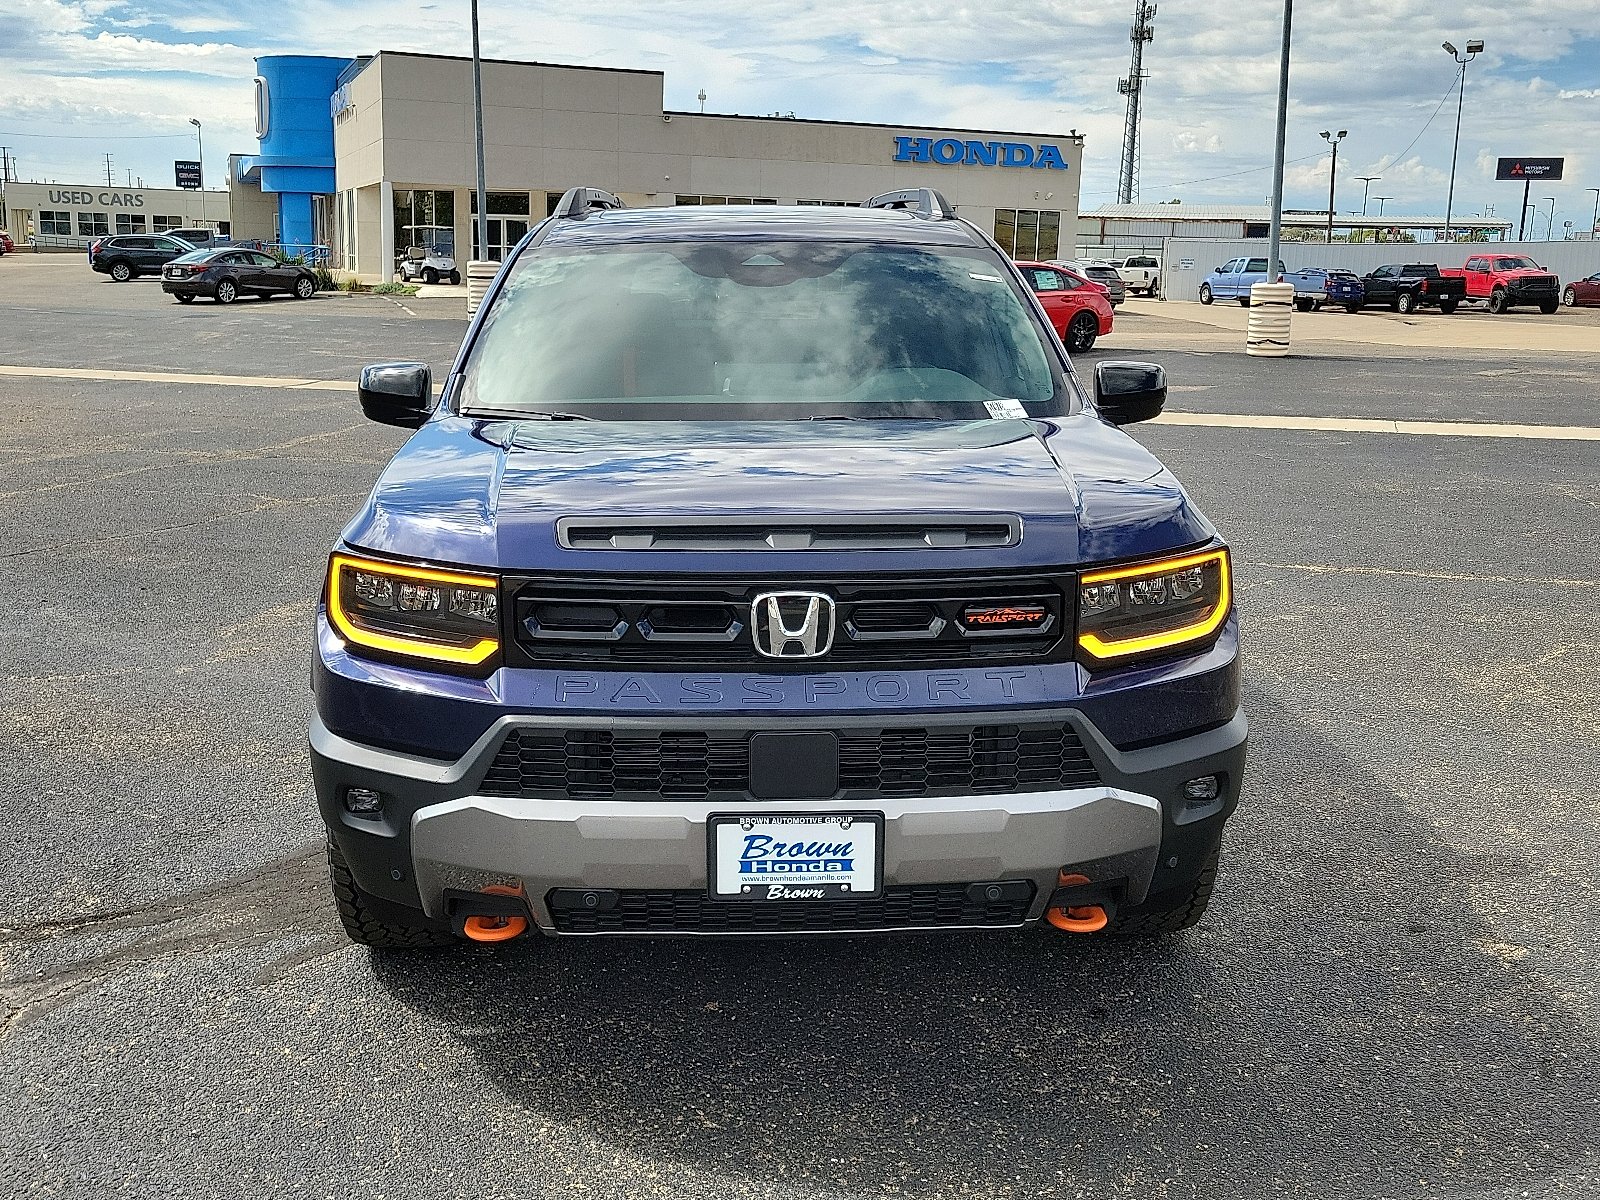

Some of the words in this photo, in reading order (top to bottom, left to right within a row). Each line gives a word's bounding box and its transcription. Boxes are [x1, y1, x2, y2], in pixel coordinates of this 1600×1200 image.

[892, 136, 1068, 170] HONDA
[48, 190, 94, 205] USED
[98, 192, 144, 207] CARS
[966, 613, 1043, 624] TRAILSPORT
[553, 671, 1026, 704] PASSPORT
[739, 817, 770, 825] BROWN
[771, 817, 823, 825] AUTOMOTIVE
[824, 816, 854, 824] GROUP
[740, 834, 854, 860] Brown
[751, 860, 843, 873] Honda
[766, 884, 826, 900] Brown
